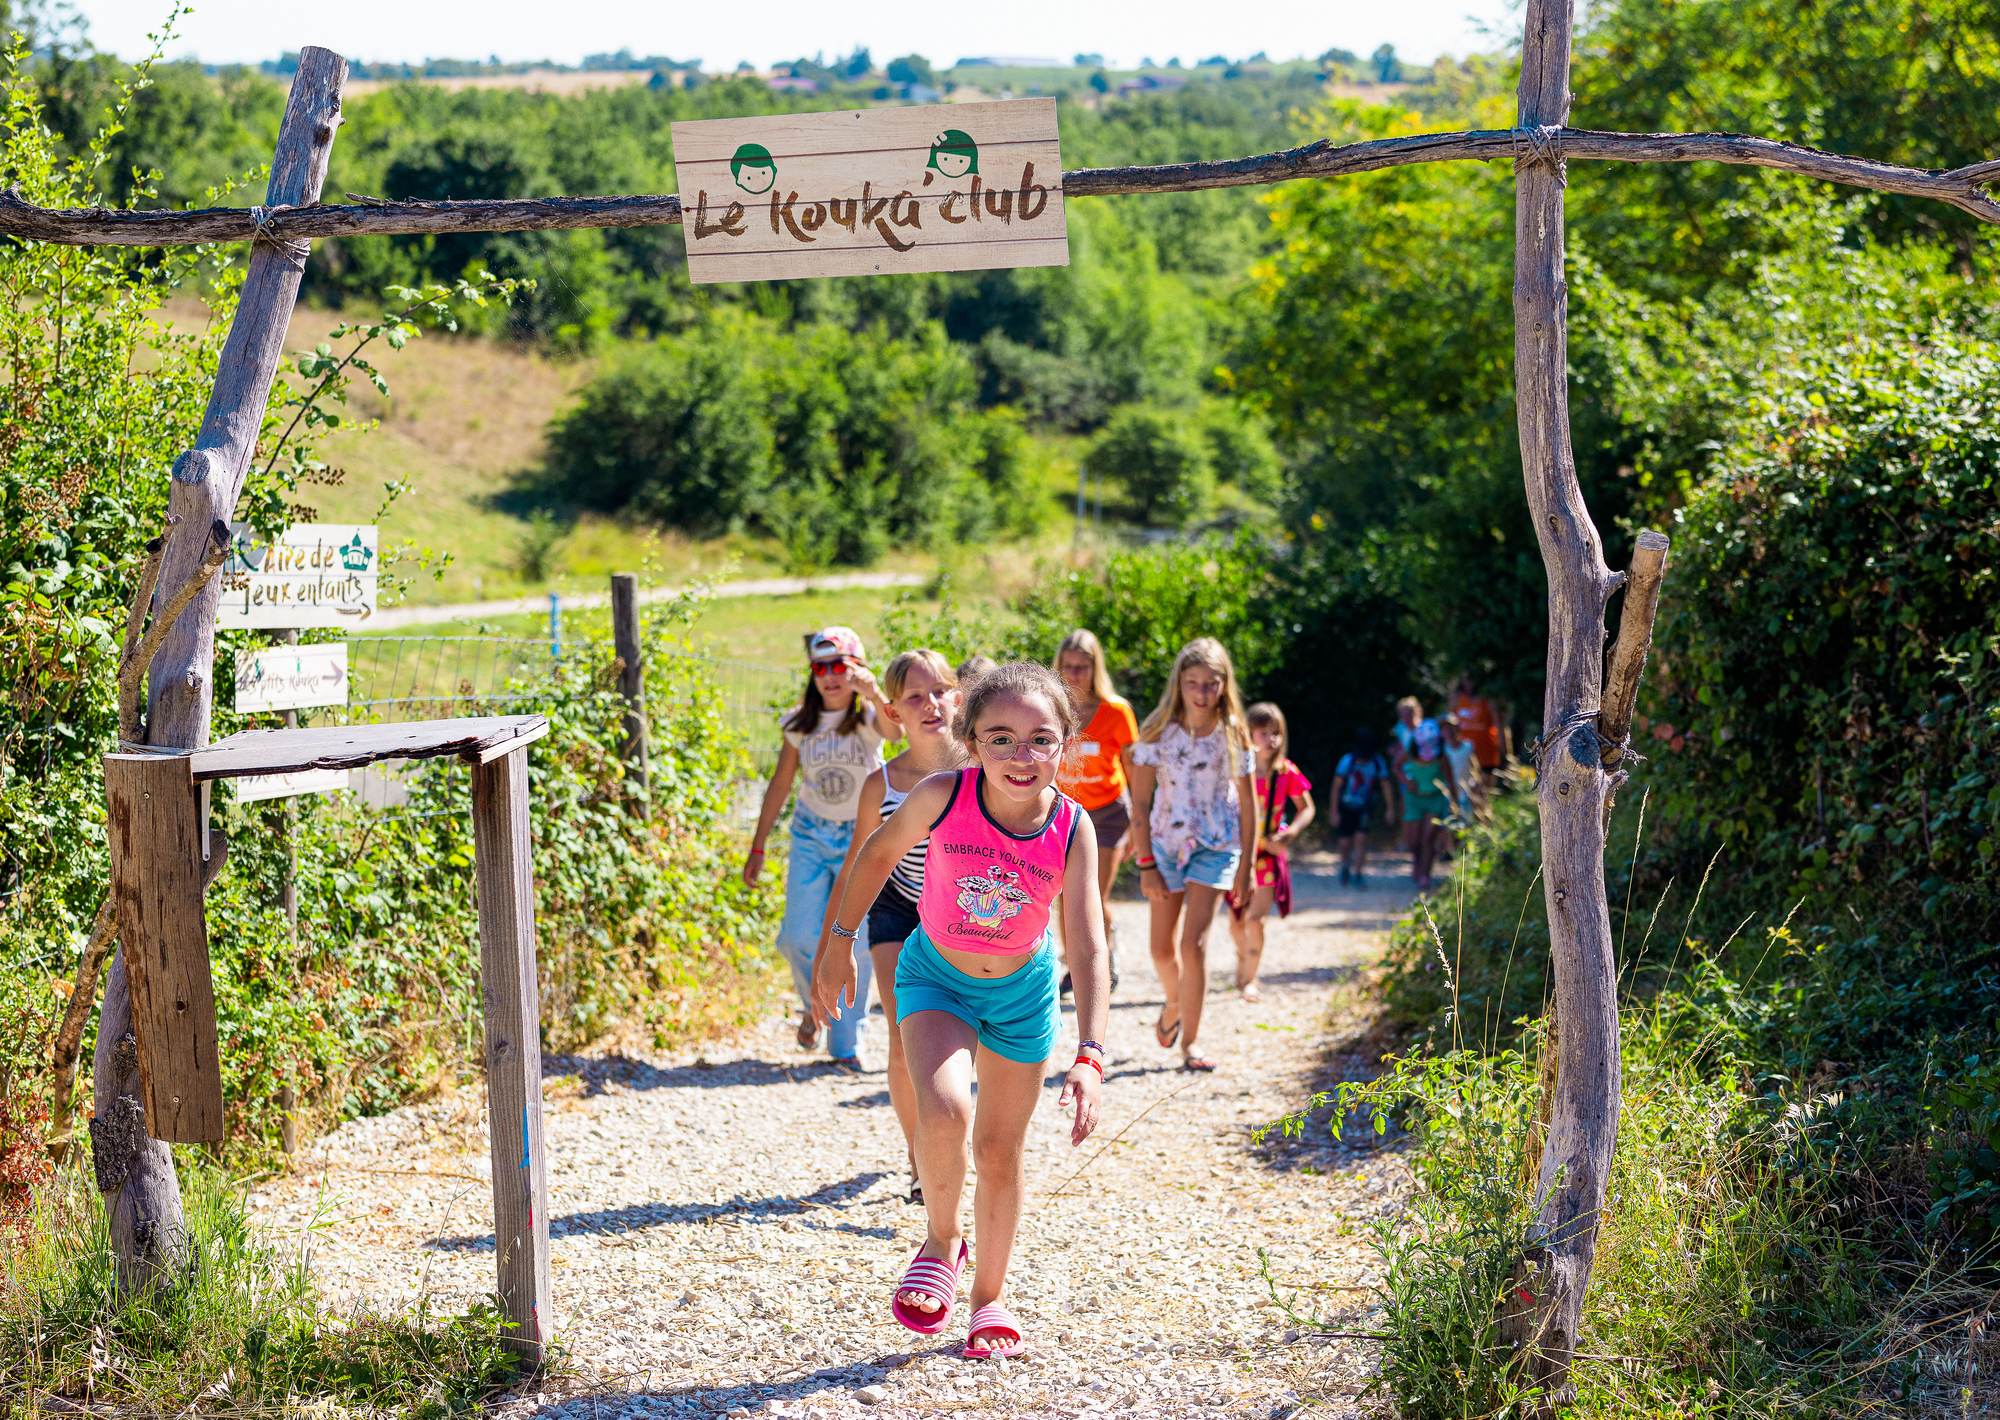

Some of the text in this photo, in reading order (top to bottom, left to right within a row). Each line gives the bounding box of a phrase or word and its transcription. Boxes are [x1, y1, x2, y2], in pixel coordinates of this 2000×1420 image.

[693, 189, 748, 240] Le
[311, 537, 335, 571] de
[943, 843, 1055, 882] EMBRACE YOUR INNER
[947, 922, 1015, 942] Beautiful
